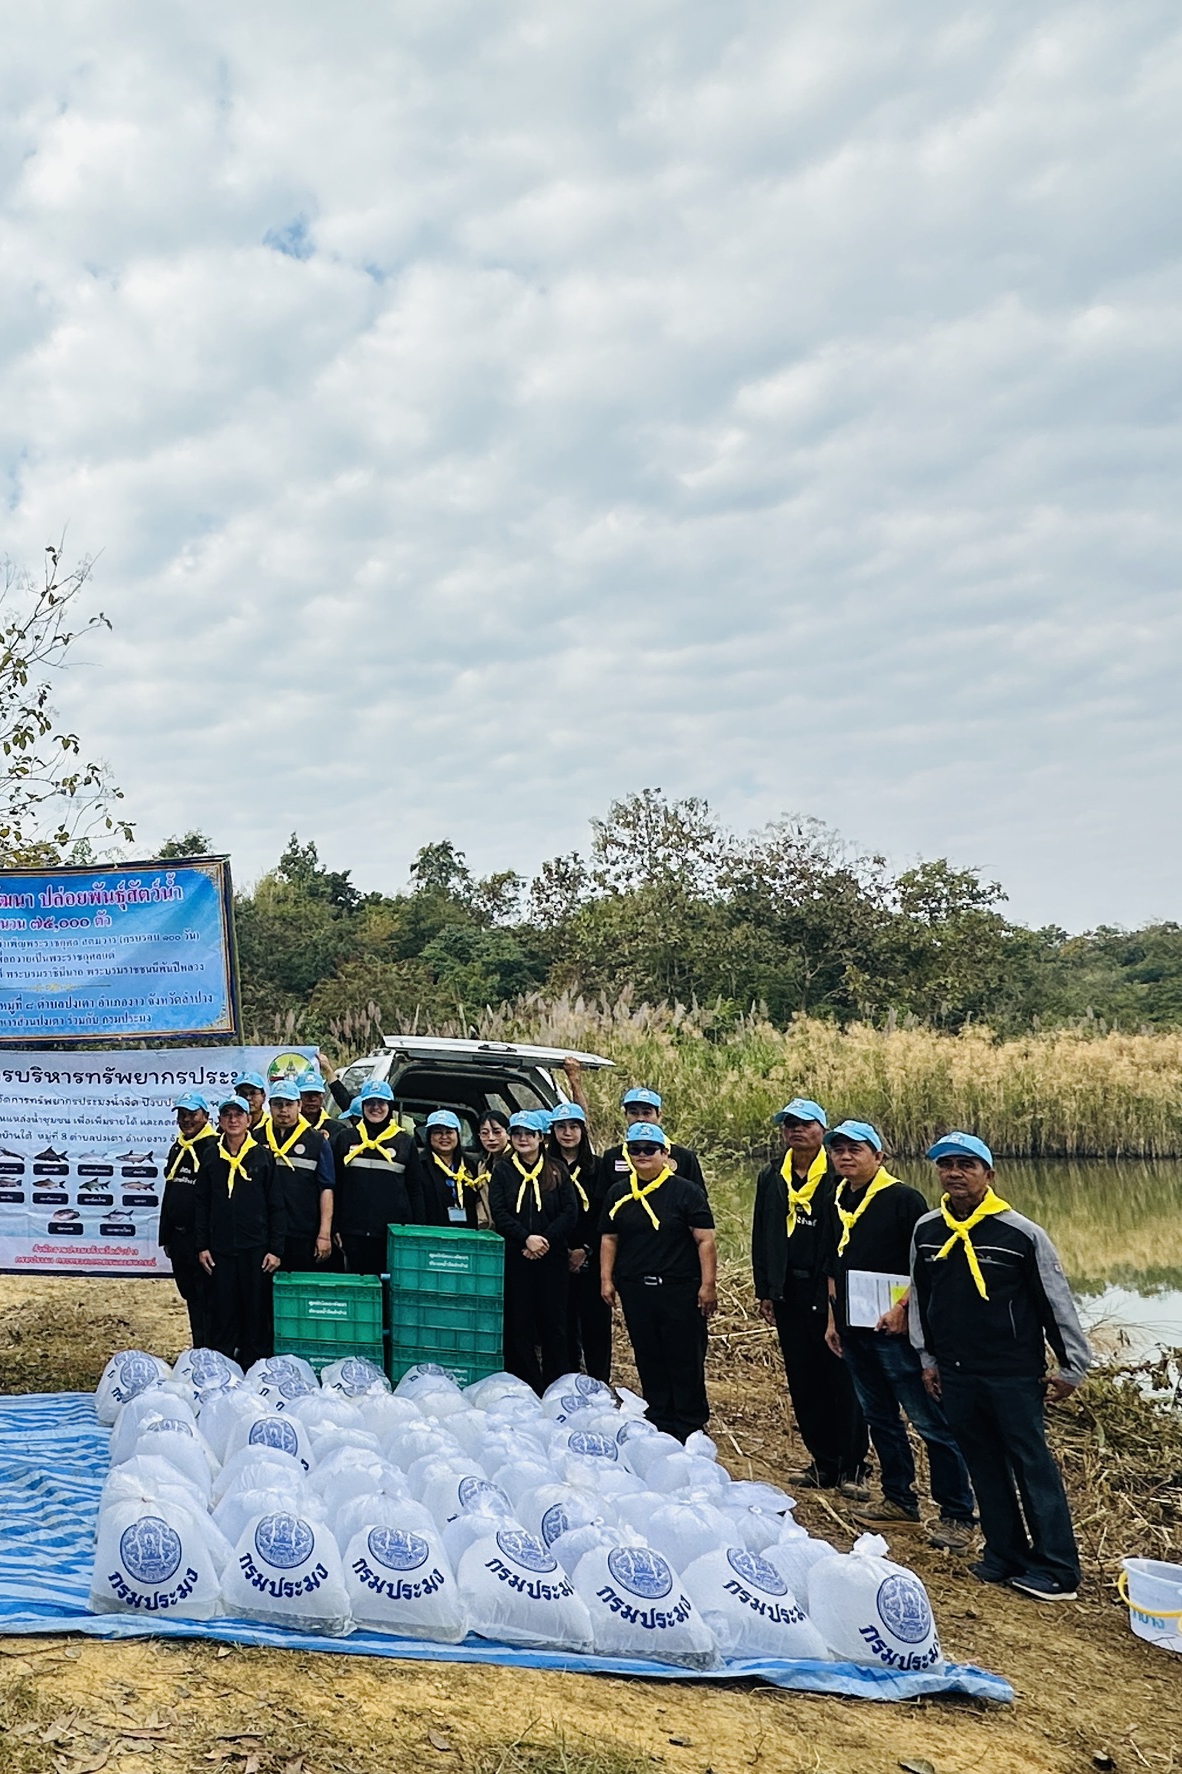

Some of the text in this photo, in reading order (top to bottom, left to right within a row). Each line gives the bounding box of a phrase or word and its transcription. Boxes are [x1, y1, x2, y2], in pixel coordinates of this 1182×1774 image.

[39, 873, 183, 910] ปล่อยพันธุ์สัตว์น้ำ
[29, 916, 90, 932] ๗๕,๐๐๐
[94, 910, 112, 927] ตัว
[107, 1567, 199, 1611] กรมประมง
[239, 1552, 330, 1598] กรมประมง
[351, 1557, 446, 1600] กรมประมง
[484, 1558, 575, 1601] กรมประม
[596, 1585, 692, 1629] กรมประมง
[722, 1579, 807, 1624] กรมประ
[859, 1625, 940, 1671] กรมประม
